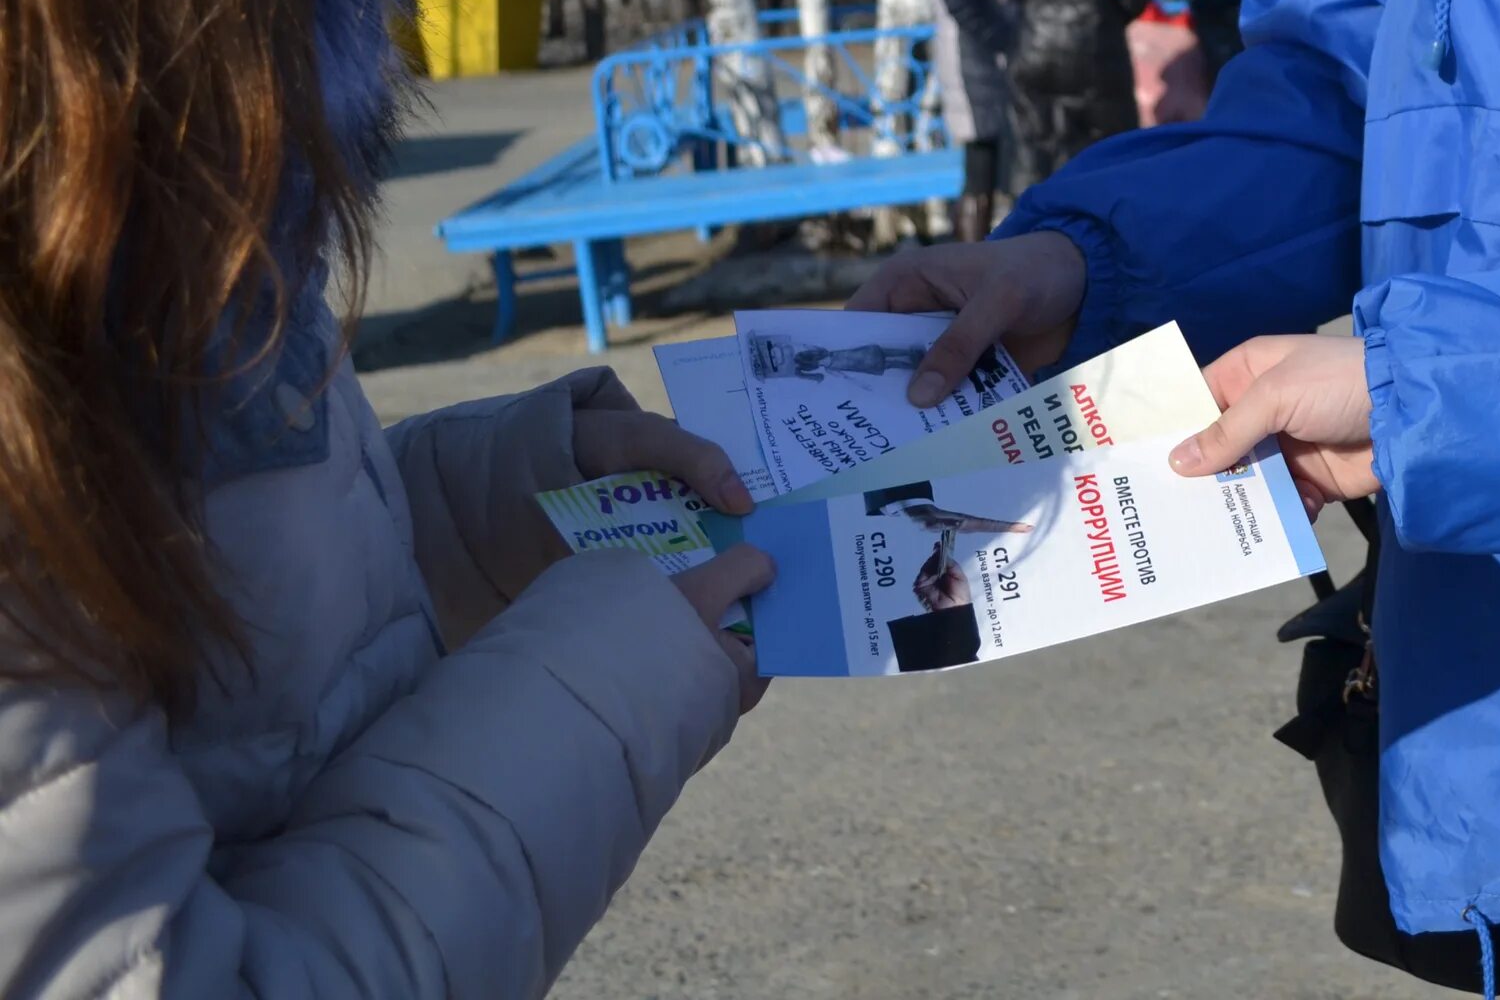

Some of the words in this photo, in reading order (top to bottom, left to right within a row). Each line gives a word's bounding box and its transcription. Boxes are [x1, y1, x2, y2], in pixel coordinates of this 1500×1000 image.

[1044, 393, 1062, 411] И
[756, 387, 778, 447] КОРРУПЦИИ
[797, 403, 827, 437] БЫТЬ
[771, 449, 784, 468] НЕТ
[1221, 485, 1236, 513] ГОРОДА
[1231, 514, 1252, 556] НОЯБРЬСКА
[1234, 483, 1263, 544] АДМИНИСТРАЦИЯ
[573, 519, 679, 548] МОДНО!
[870, 532, 886, 553] ст.
[1074, 473, 1127, 603] КОРРУПЦИИ
[1113, 475, 1141, 530] ВМЕСТЕ
[1128, 530, 1156, 585] ПРОТИВ
[854, 534, 868, 581] Получение
[874, 556, 896, 588] 290
[975, 550, 988, 573] Дача
[993, 547, 1010, 568] ст.
[861, 581, 873, 612] взятки
[982, 573, 993, 602] взятки
[998, 571, 1021, 601] 291
[864, 616, 875, 629] до
[987, 608, 997, 620] до
[991, 621, 1001, 633] 12
[868, 629, 879, 641] 15
[870, 642, 880, 657] лет
[994, 633, 1003, 648] лет
